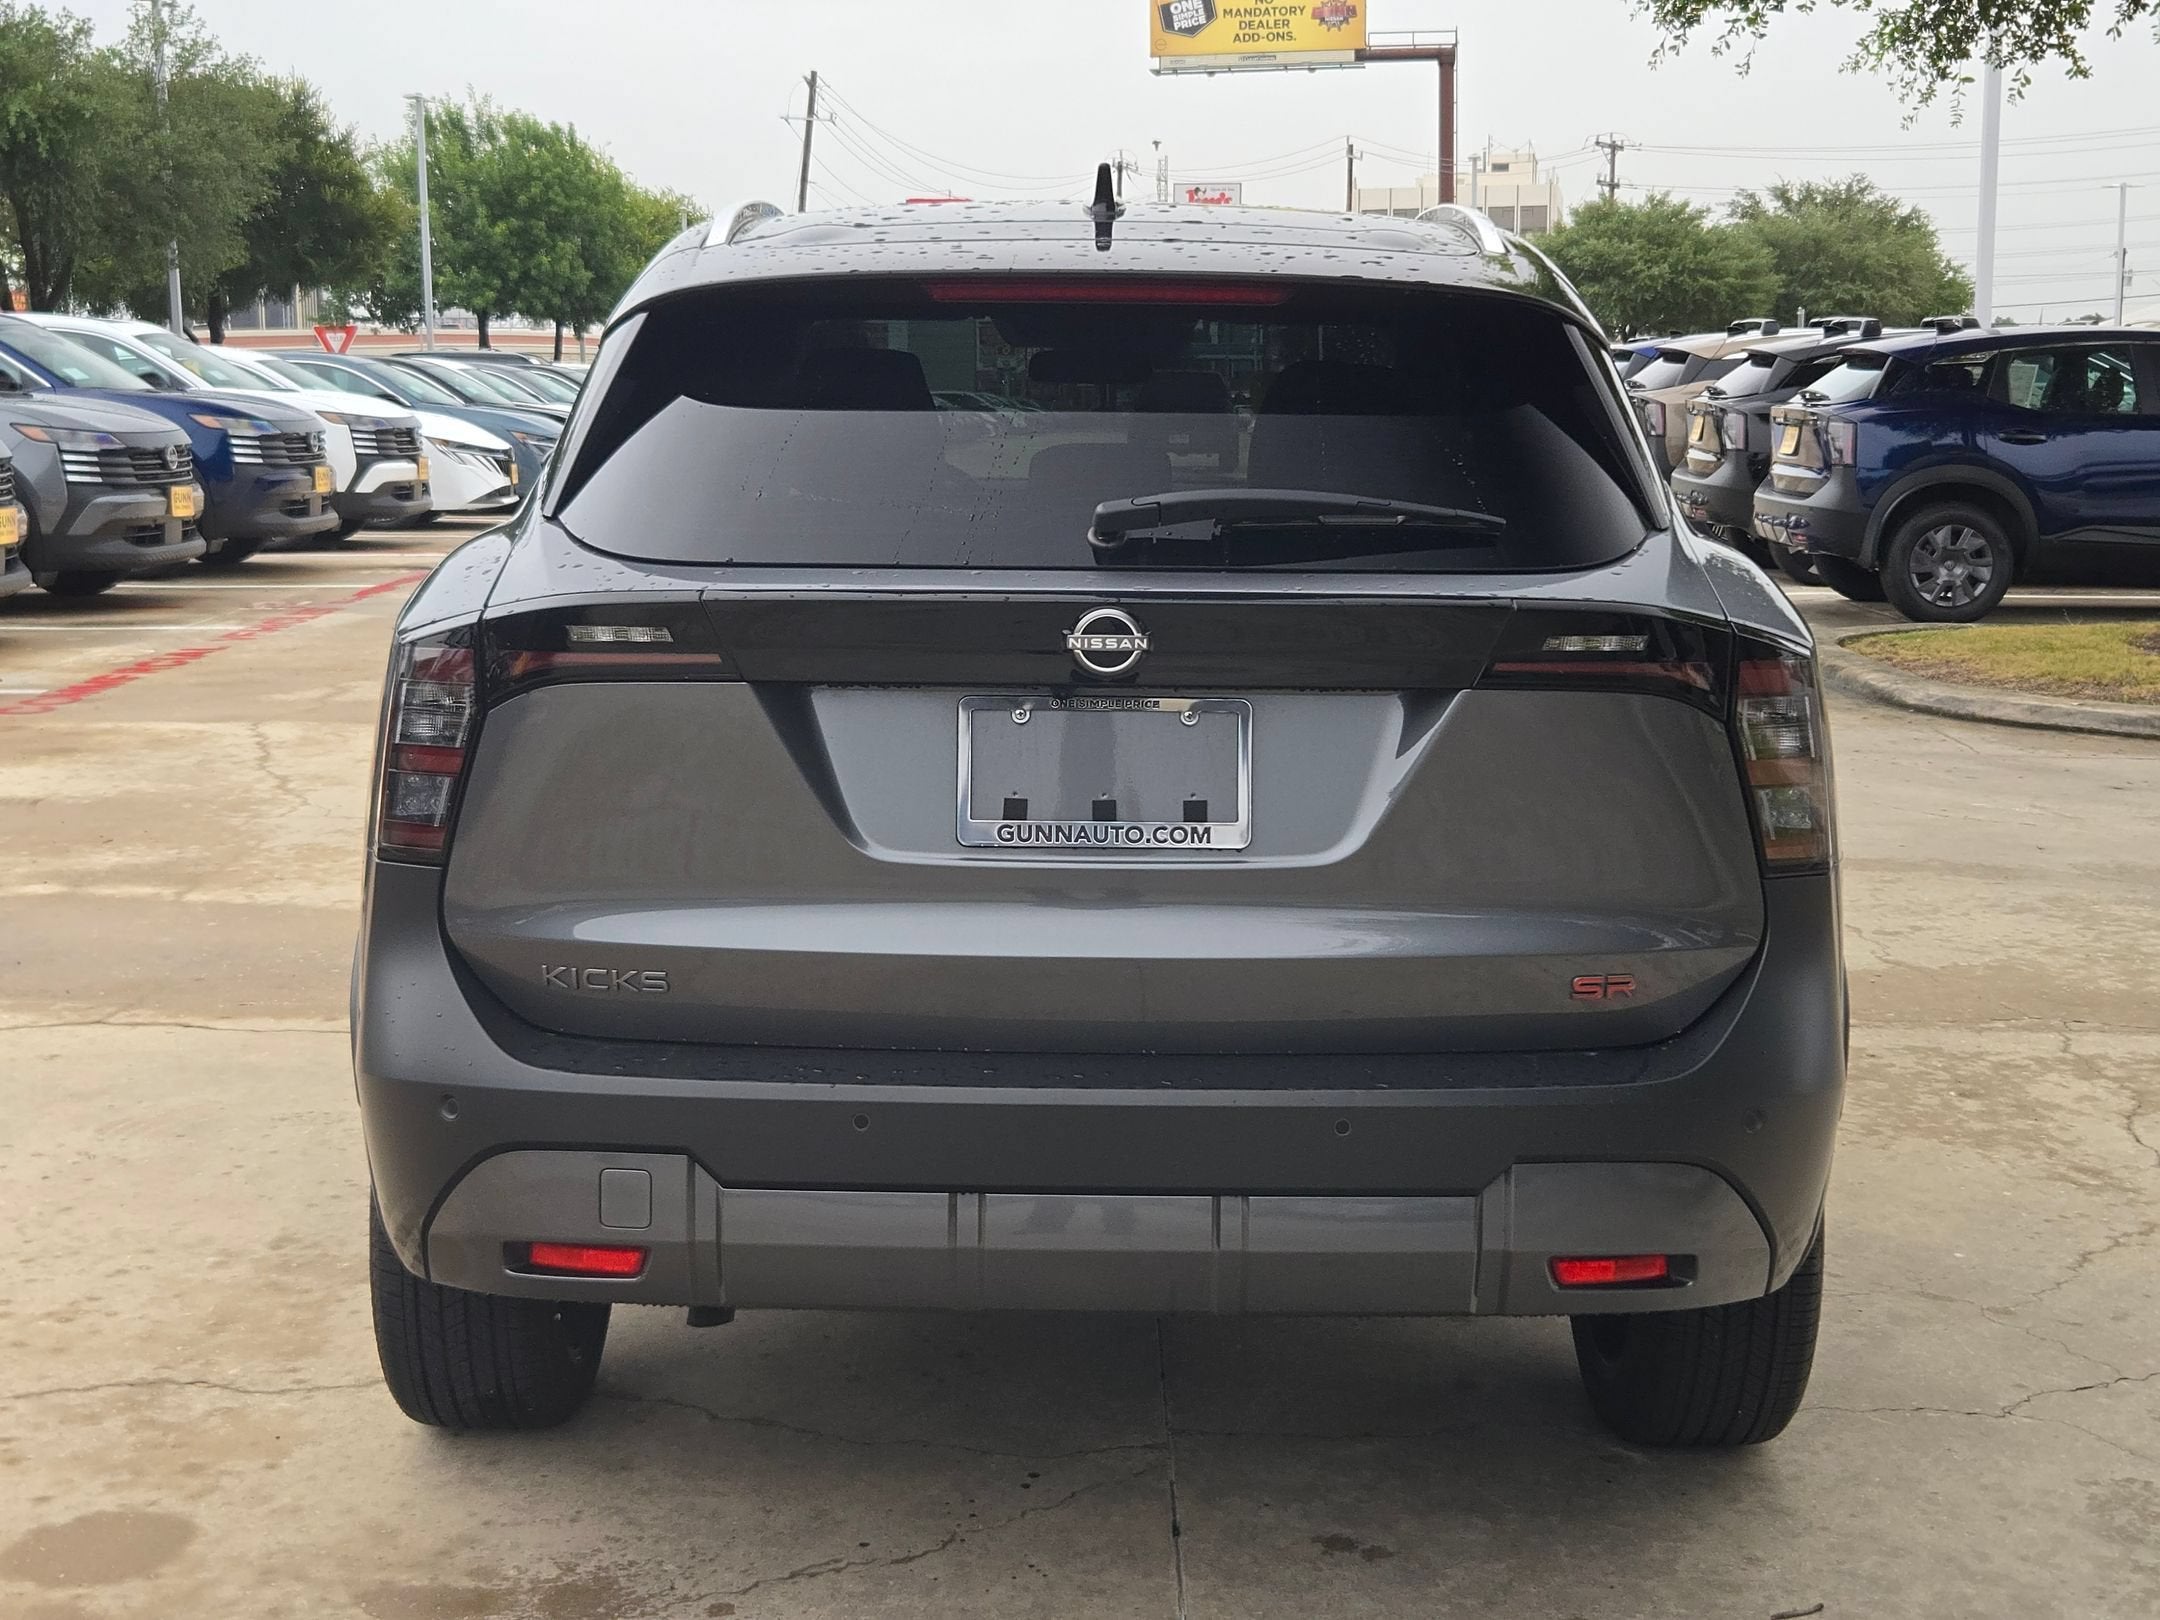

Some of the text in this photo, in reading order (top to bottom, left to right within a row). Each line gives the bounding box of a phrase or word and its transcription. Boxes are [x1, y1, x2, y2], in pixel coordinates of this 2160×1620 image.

[1170, 0, 1203, 14] ONE
[1223, 5, 1306, 19] MANDATORY
[1172, 8, 1204, 21] SIMPLE
[1174, 15, 1206, 31] PRICE
[1239, 19, 1290, 30] DEALER
[1233, 31, 1297, 43] ADD-ONS.
[1068, 638, 1148, 649] NISSAN
[1051, 698, 1161, 710] ONE SIMPLE PRICE
[996, 824, 1213, 845] GUNNAUTO.COM
[541, 963, 670, 993] KICKS
[1569, 974, 1637, 1000] SR
